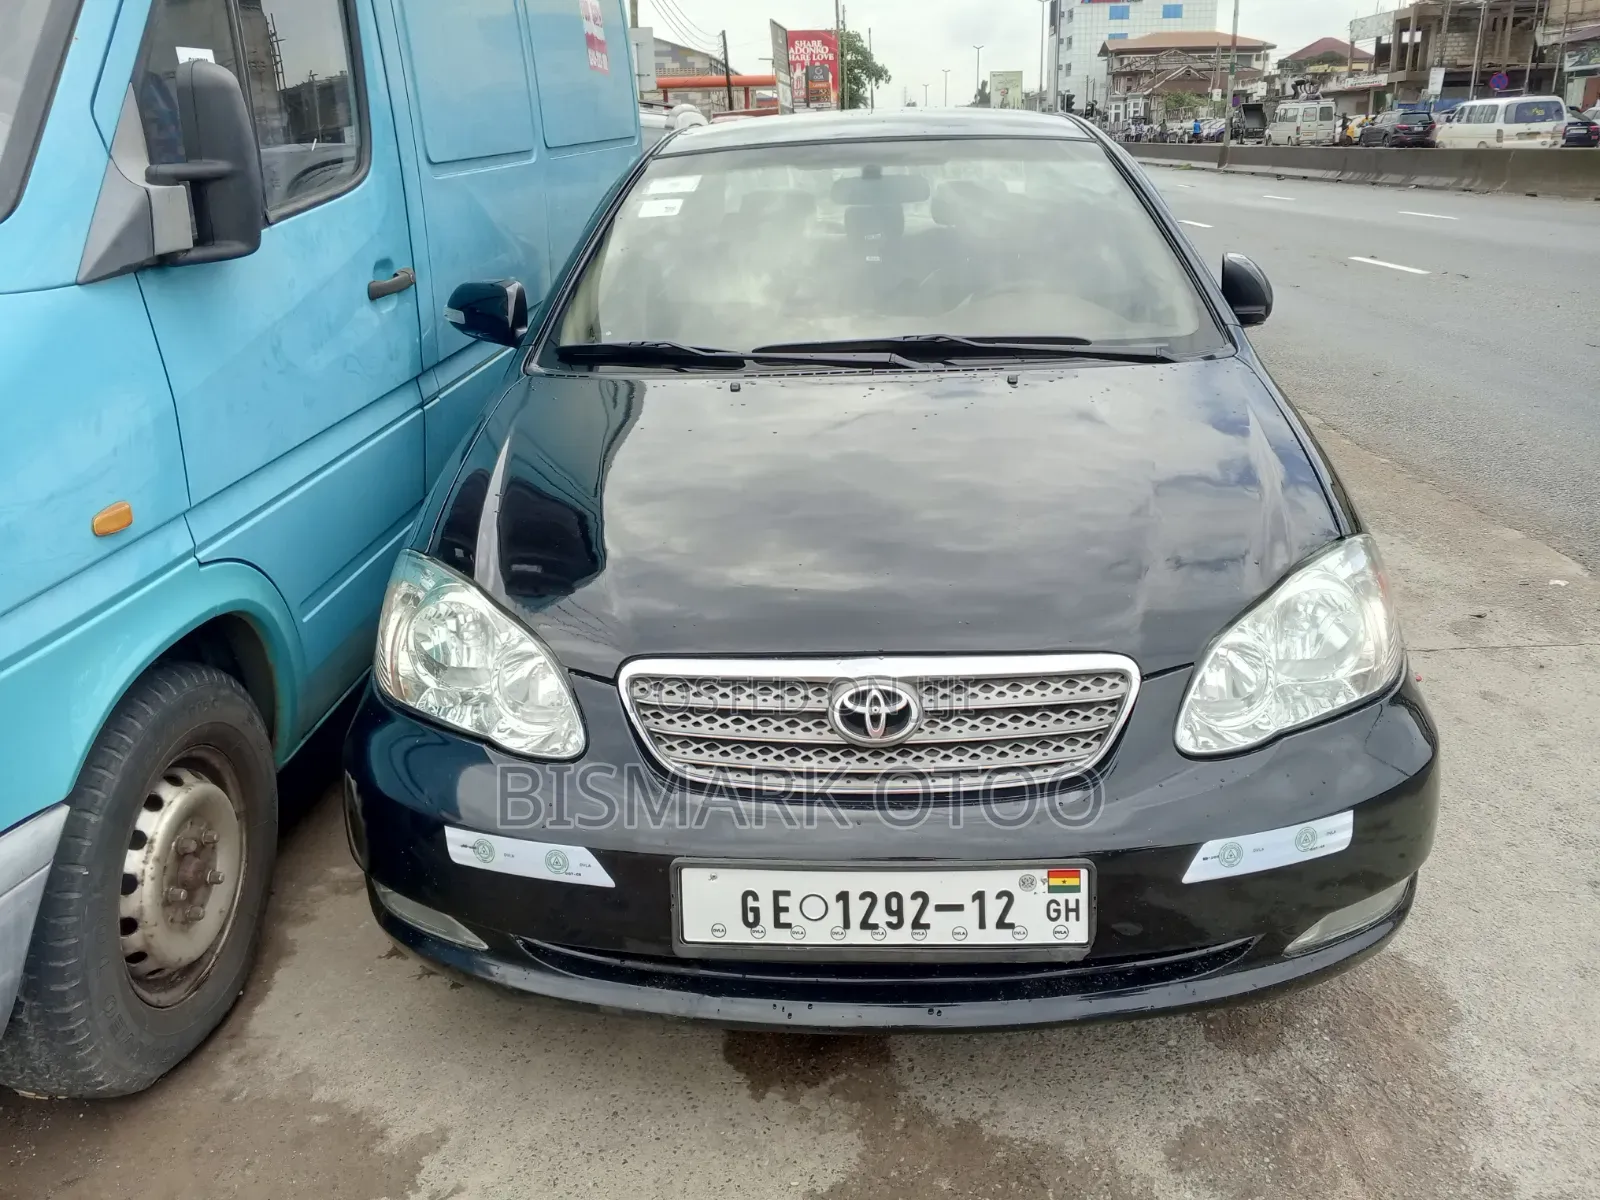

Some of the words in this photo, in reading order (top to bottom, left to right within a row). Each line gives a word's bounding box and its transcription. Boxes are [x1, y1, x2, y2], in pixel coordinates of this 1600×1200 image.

[789, 46, 829, 54] ADONKO
[741, 889, 793, 929] GE
[834, 889, 1016, 931] 1292-12
[1046, 898, 1080, 922] GH
